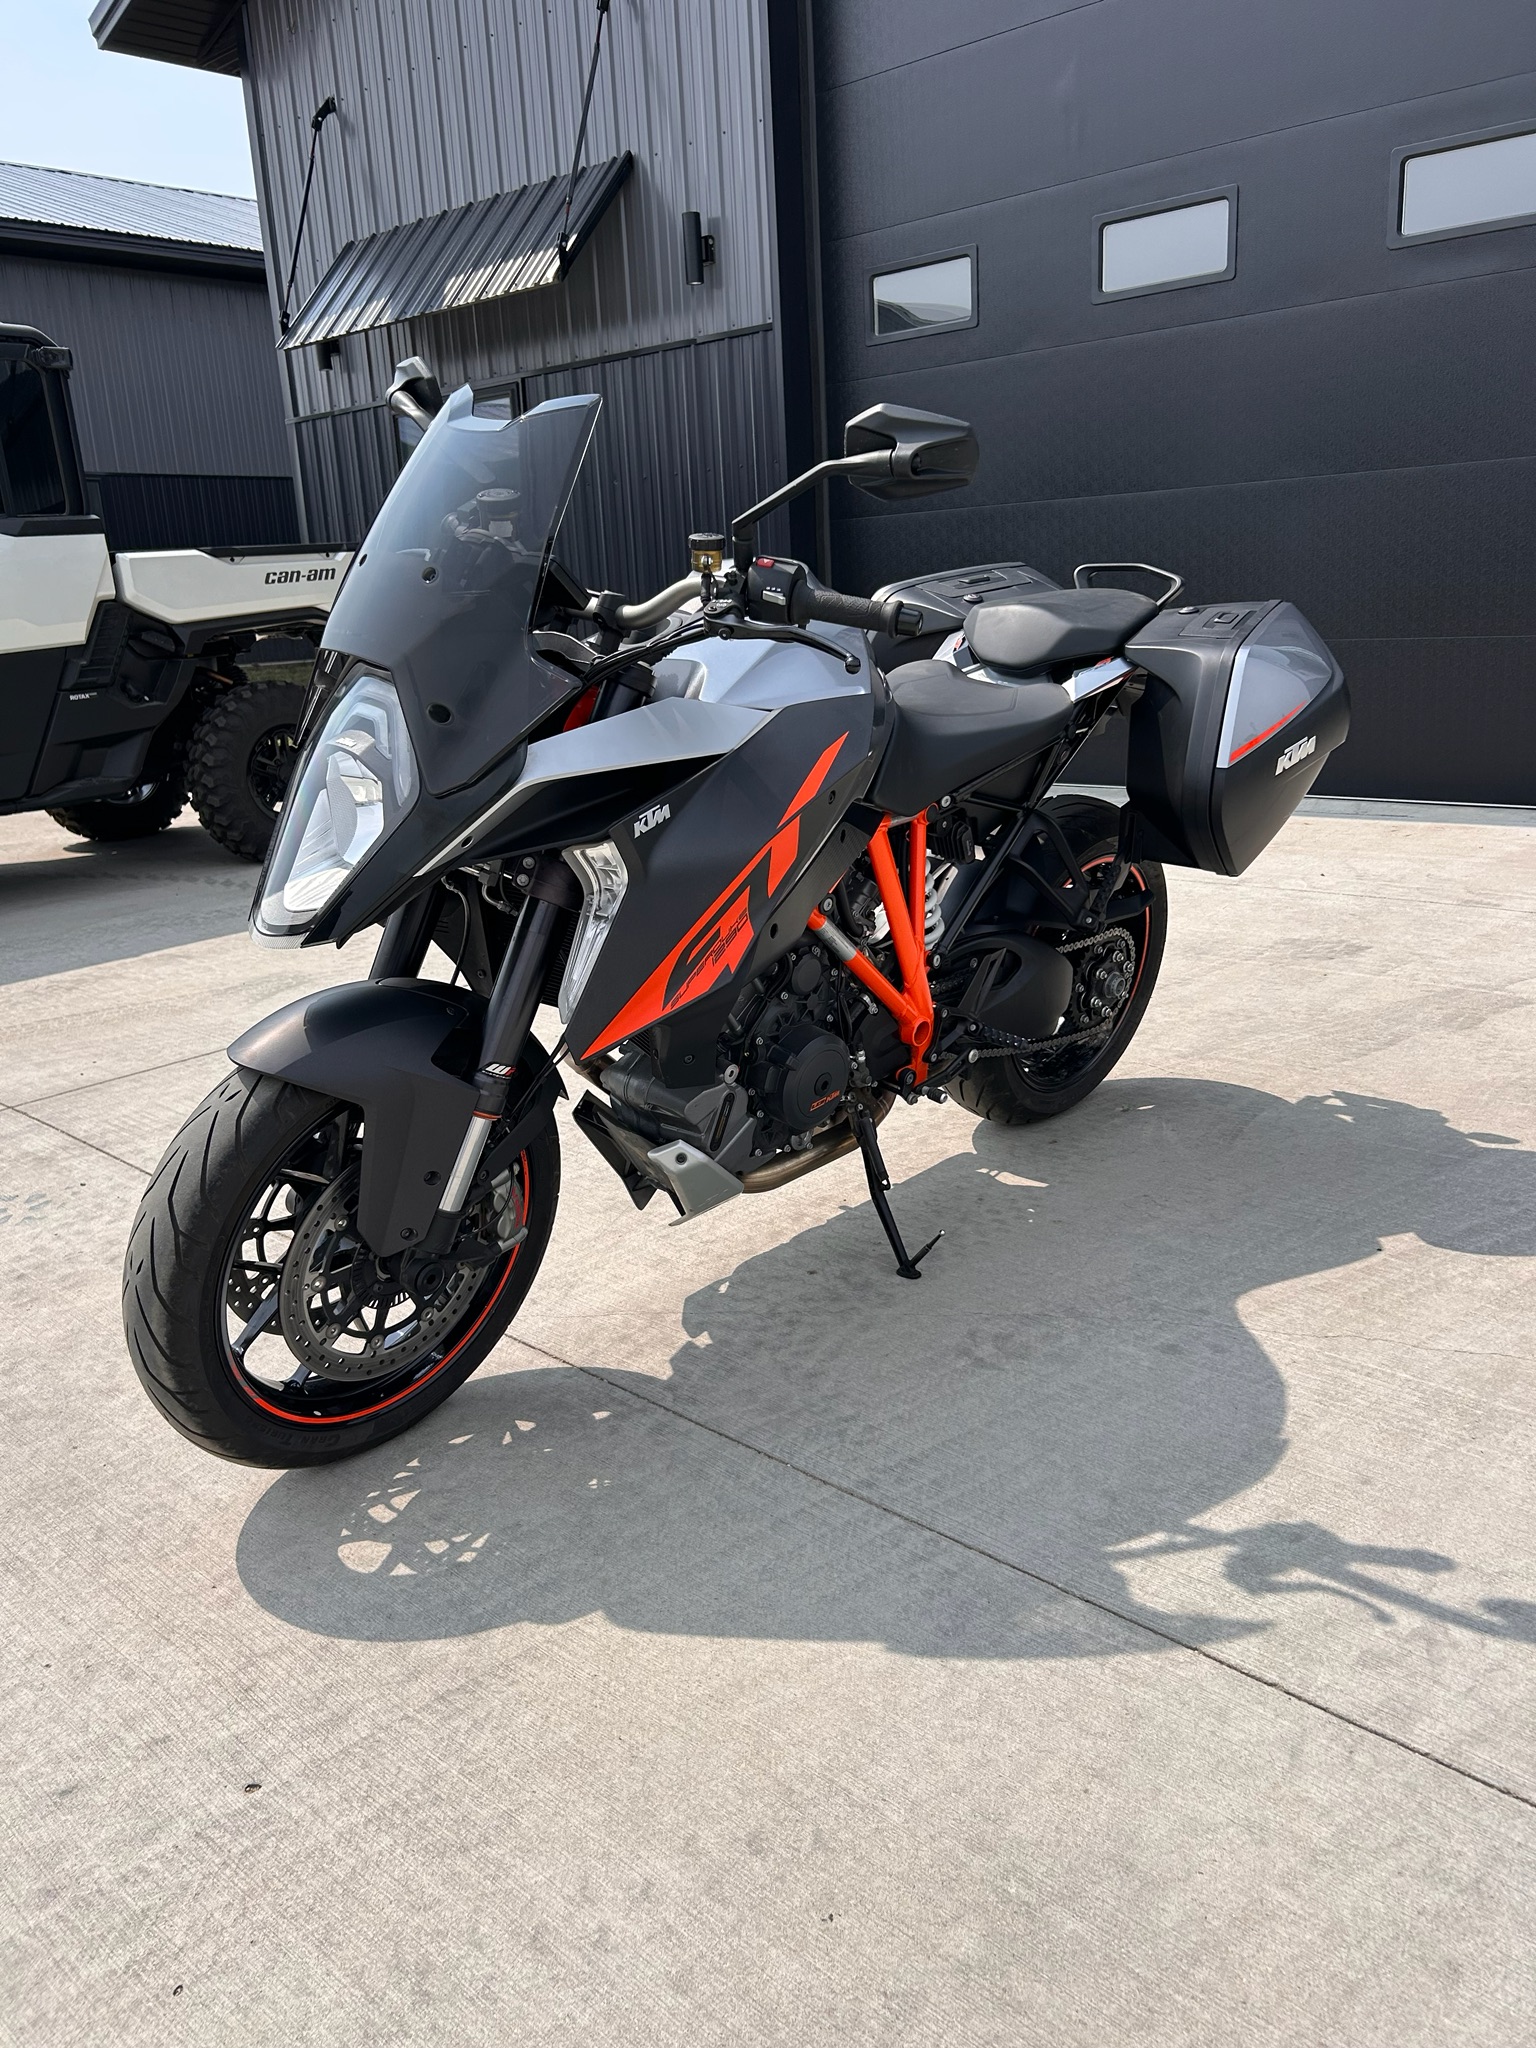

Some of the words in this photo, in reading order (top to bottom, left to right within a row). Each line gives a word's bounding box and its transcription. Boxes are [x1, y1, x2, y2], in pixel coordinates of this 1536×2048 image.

[264, 567, 337, 585] can-am
[69, 692, 90, 701] ROTAX
[1274, 735, 1317, 776] KTM
[633, 803, 671, 839] KTM
